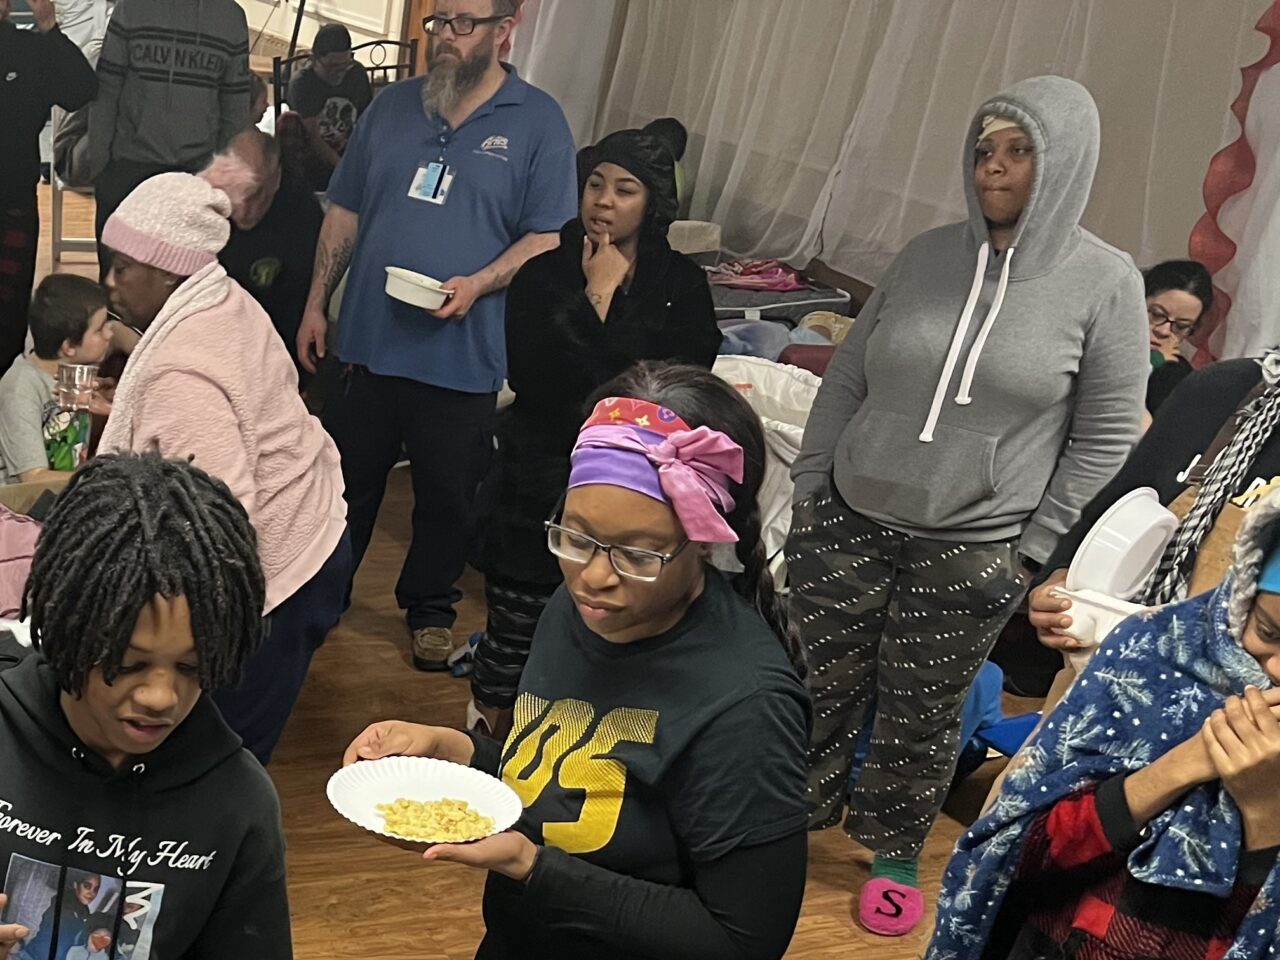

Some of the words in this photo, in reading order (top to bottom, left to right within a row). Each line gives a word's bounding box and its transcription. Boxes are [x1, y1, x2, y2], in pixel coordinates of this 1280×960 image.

[132, 43, 186, 67] CALVN
[68, 826, 94, 854] In
[96, 834, 147, 876] My
[147, 840, 217, 870] Heart
[874, 889, 907, 918] S
